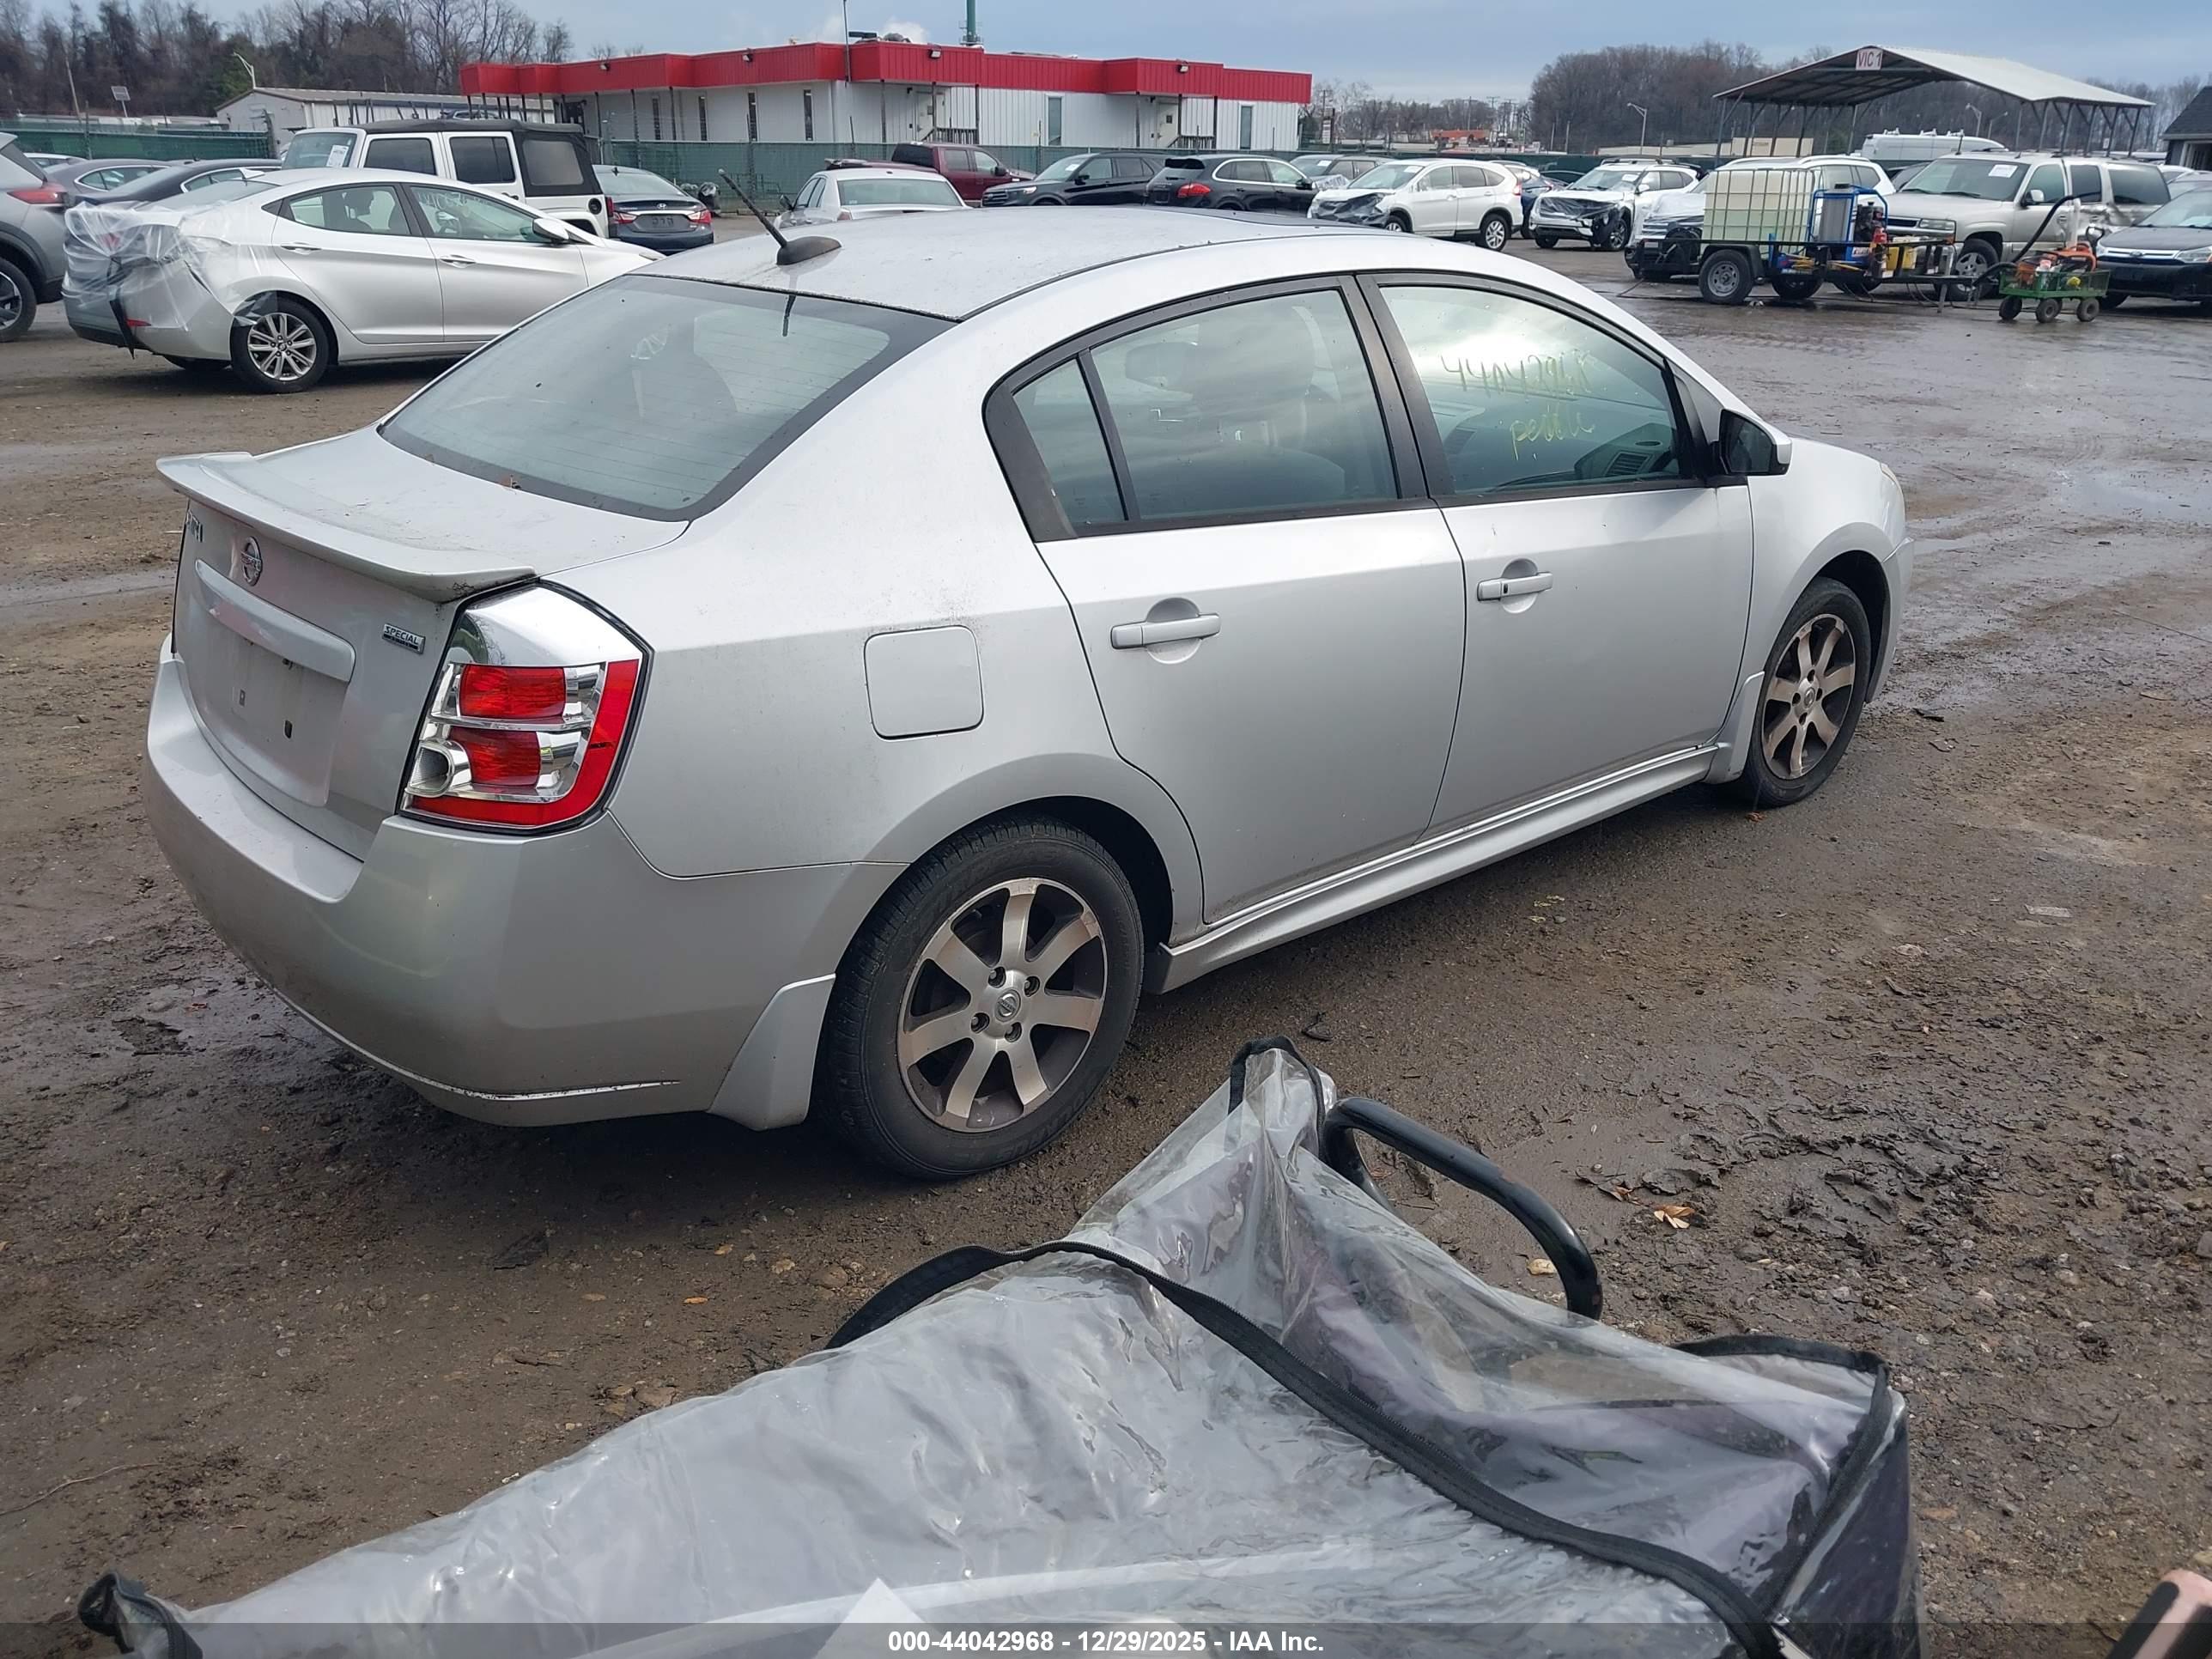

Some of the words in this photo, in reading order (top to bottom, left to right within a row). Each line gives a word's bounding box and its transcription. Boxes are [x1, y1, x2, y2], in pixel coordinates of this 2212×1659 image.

[1858, 52, 1874, 67] VIC
[1876, 52, 1881, 67] 1
[385, 626, 419, 645] SPECIAL
